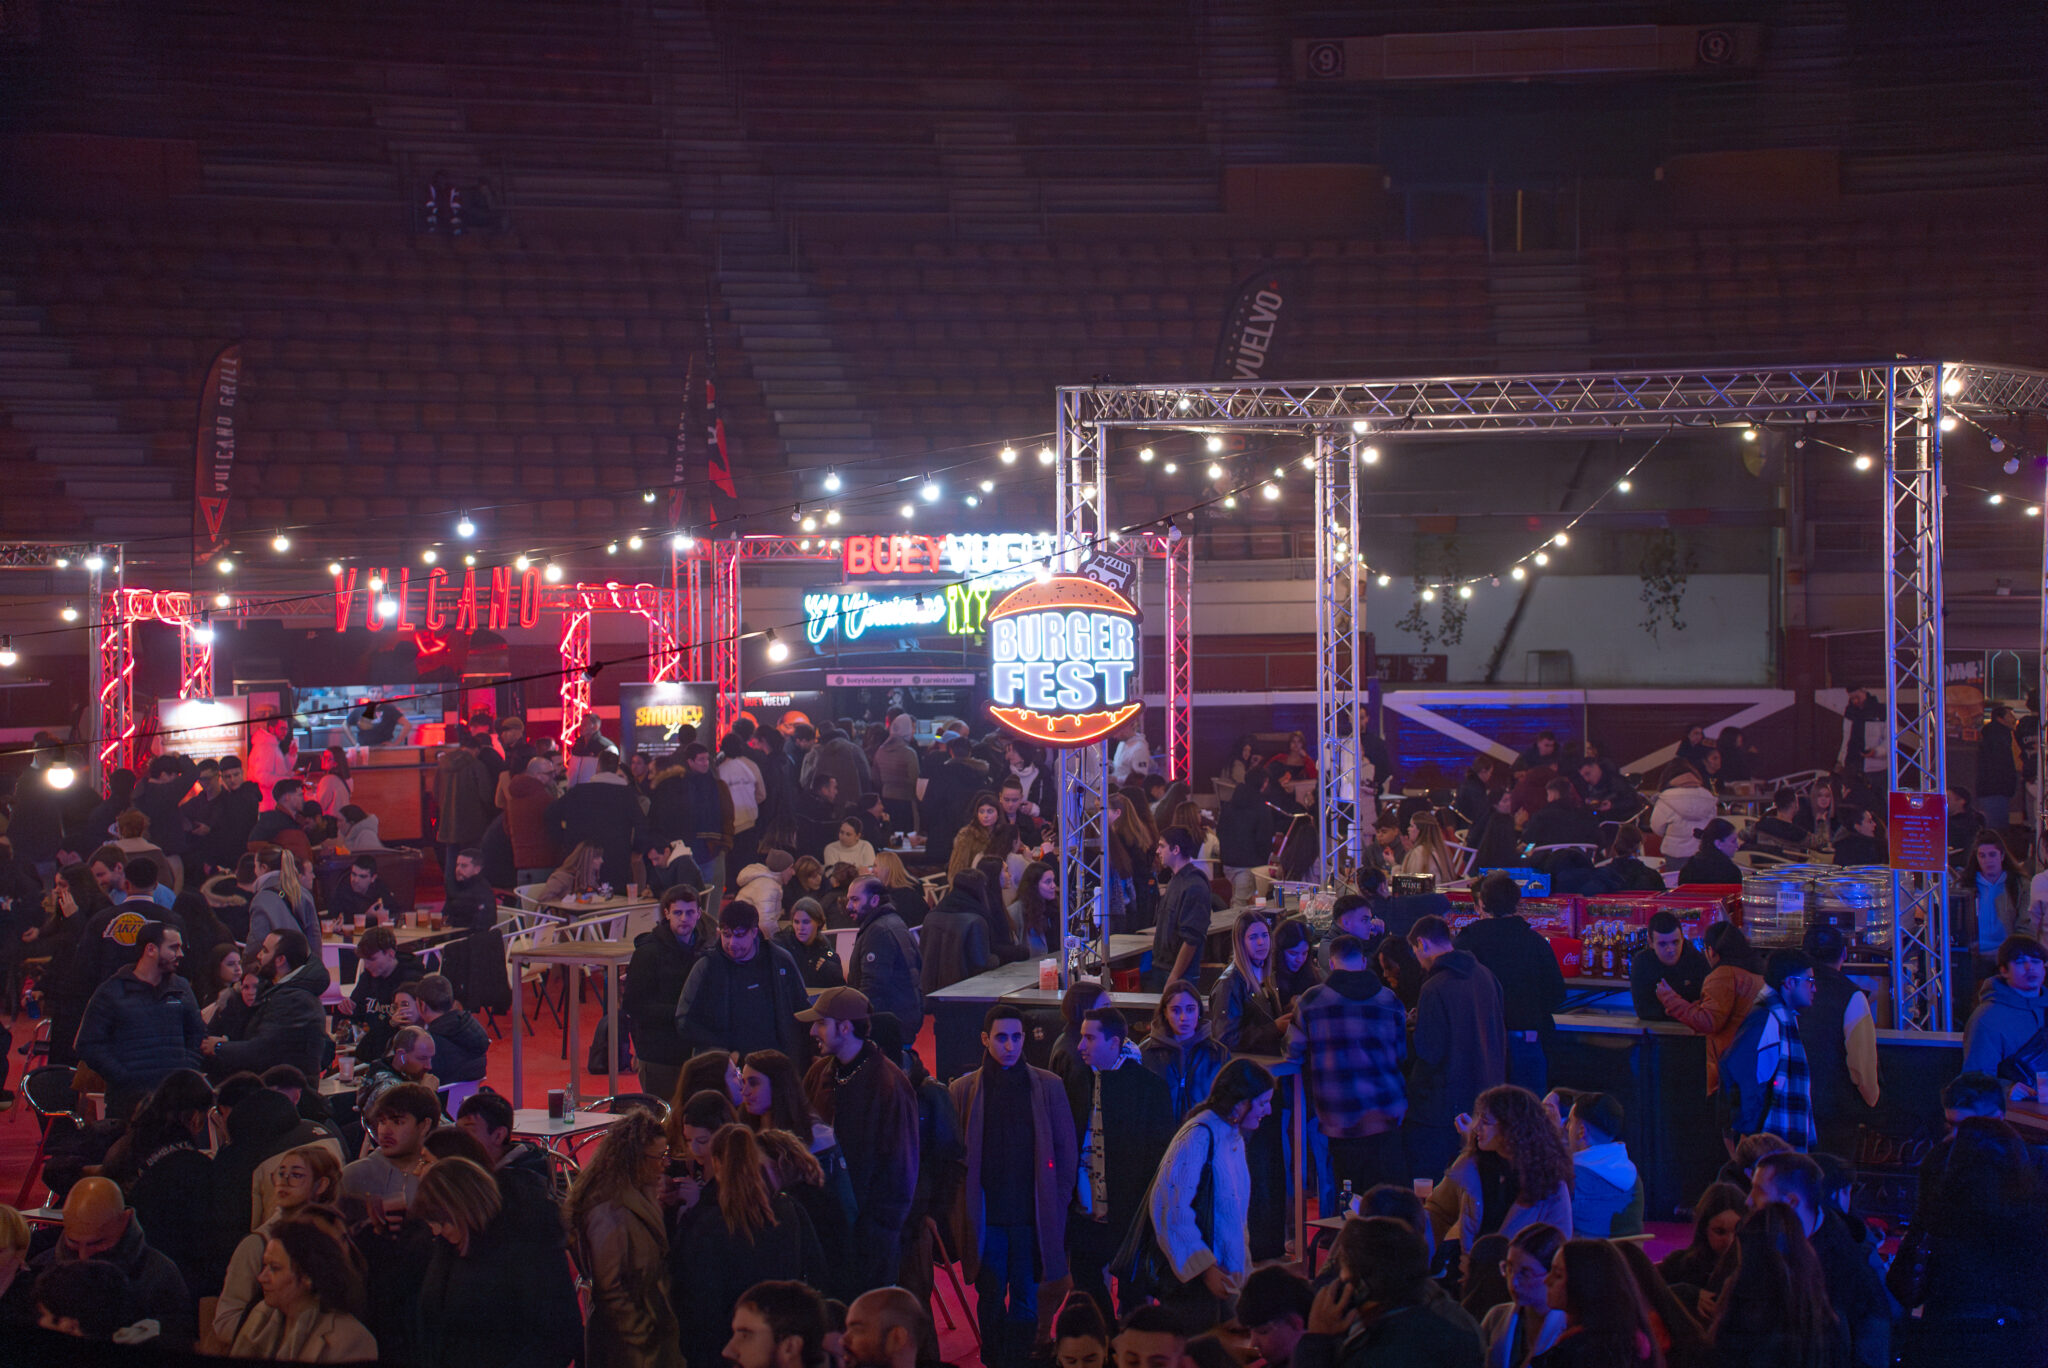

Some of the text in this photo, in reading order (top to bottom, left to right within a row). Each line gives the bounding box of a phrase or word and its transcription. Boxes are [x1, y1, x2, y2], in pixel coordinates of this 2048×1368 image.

[1231, 290, 1284, 379] VUELVO
[334, 565, 542, 633] VULCANO
[992, 611, 1135, 662] BURGER
[992, 660, 1135, 710] FEST
[635, 704, 704, 727] SMOKEY
